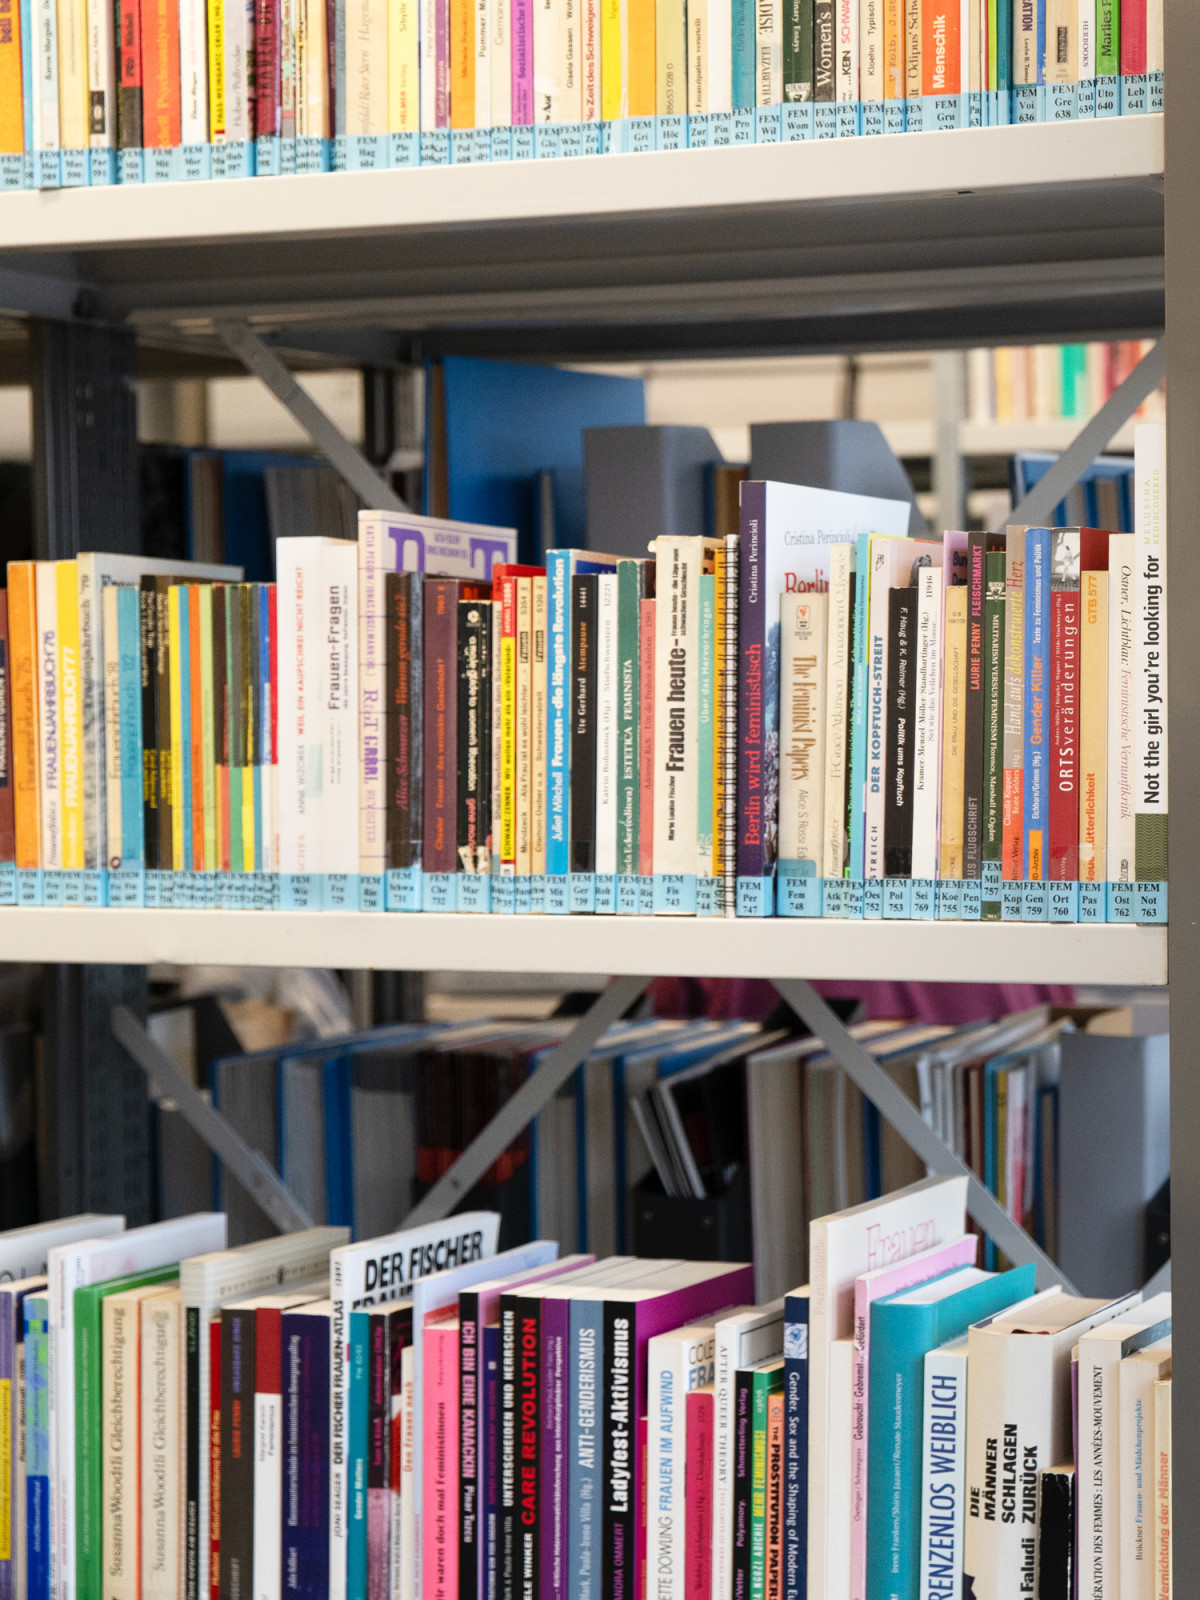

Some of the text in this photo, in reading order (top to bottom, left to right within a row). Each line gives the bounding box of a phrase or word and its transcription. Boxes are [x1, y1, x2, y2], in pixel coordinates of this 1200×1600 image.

[566, 27, 574, 61] Gassen
[793, 25, 801, 53] Essays
[816, 11, 832, 87] Women's
[867, 1, 876, 76] Kloehn Typisch
[933, 14, 946, 89] Menschik
[1101, 9, 1112, 57] Marlies
[586, 63, 595, 106] Zeit des
[761, 46, 771, 96] ELIZABETH
[1052, 85, 1075, 94] FEM
[1096, 75, 1117, 85] FEM
[1098, 89, 1113, 98] Uto
[1124, 75, 1147, 85] FEM
[1127, 88, 1145, 97] Leb
[1054, 98, 1072, 107] Gre
[1055, 110, 1071, 119] 638
[1098, 101, 1113, 110] 640
[1128, 100, 1143, 109] 641
[1152, 468, 1160, 543] REDISCOVERED
[749, 519, 759, 603] Cristina Perincioli
[1034, 543, 1042, 563] Politik
[1034, 564, 1042, 577] und
[1033, 578, 1042, 616] Feminismus
[1088, 575, 1097, 624] GTB 577
[327, 584, 342, 709] Frauen-Fragen
[899, 616, 907, 688] Haug Reimer
[1005, 561, 1023, 734] Hand aufs dekonstruierte Herz
[1033, 626, 1042, 643] Texte
[578, 621, 588, 734] Ute Gerhard Atempause
[700, 600, 712, 722] Über das Hervorbringen
[1031, 655, 1042, 691] Killer
[1143, 554, 1163, 803] Not the girl you're looking for
[552, 558, 566, 841] Juliet Mitchell Frauen die längste Revolution
[871, 635, 882, 793] DER KOPFTUCH-STREIT
[967, 545, 982, 859] FLUGSCHRIFT LAURIE PENNY FLEISCHMARKT
[1059, 602, 1077, 791] ORTSveränderungen
[1119, 565, 1132, 820] Ostner, Lichtblau: Feministische Vernunftkritik
[623, 659, 633, 779] ESTETICA FEMINISTA
[667, 707, 686, 771] Frauen
[785, 655, 817, 781] The Feminist Papers
[898, 718, 906, 745] Politik
[1031, 697, 1043, 744] Gender
[744, 643, 761, 845] Berlin wird feministisch
[1031, 750, 1042, 767] (Hg.)
[896, 767, 905, 806] Kopftuch
[1004, 769, 1013, 825] Claudia Koppert
[1012, 768, 1020, 814] Beate Selders
[1031, 768, 1042, 819] Eichhorn/Grimm
[1024, 882, 1046, 891] FEM
[1025, 894, 1043, 903] Gen
[1026, 906, 1042, 915] 759
[1050, 882, 1072, 891] FEM
[1052, 895, 1069, 904] Ort
[1079, 883, 1101, 892] FEM
[1082, 895, 1097, 904] Pas
[1111, 883, 1133, 892] FEM
[1114, 895, 1129, 905] Ost
[1137, 883, 1160, 892] FEM
[1141, 895, 1157, 904] Not
[1053, 907, 1068, 915] 760
[1082, 907, 1097, 917] 761
[1114, 908, 1129, 917] 762
[1141, 908, 1157, 917] 763
[365, 1230, 483, 1291] DER FISCHER
[333, 1391, 344, 1438] FISCHER
[462, 1321, 475, 1479] ICH BIN EINE KANACKIN
[503, 1311, 514, 1507] UNTERSCHEIDEN UND HERRSCHEN
[578, 1329, 596, 1469] ANTI-GENDERISMUS
[609, 1318, 631, 1512] Ladyfest-Aktivismus
[717, 1345, 728, 1484] AFTER QUEER THEORY
[853, 1403, 865, 1441] Gebraucht
[930, 1375, 957, 1474] WEIBLICH
[1135, 1399, 1144, 1470] Mädchenprojekte
[333, 1440, 344, 1465] DER
[521, 1319, 536, 1579] WINKER CARE REVOLUTION
[657, 1370, 674, 1575] DOWLING FRAUEN IM AUFWIND
[1092, 1365, 1103, 1554] DES FEMMES LES ANNÉES-MOUVEMENT
[436, 1402, 446, 1585] waren doch mal Feministinnen
[753, 1430, 765, 1557] ADICHIE MEHR FEMINISMUS!
[769, 1443, 781, 1548] PROSTITUTION
[786, 1372, 801, 1586] Gender, Sex and the Shaping of Modern
[982, 1438, 997, 1521] MÄNNER
[1002, 1424, 1017, 1524] SCHLAGEN
[1019, 1446, 1038, 1524] ZURÜCK
[1158, 1452, 1169, 1500] Männer
[969, 1486, 979, 1518] DIE
[1135, 1491, 1143, 1524] Frauen-
[1158, 1505, 1169, 1526] der
[1020, 1537, 1035, 1592] Faludi
[1135, 1526, 1143, 1561] Brückner
